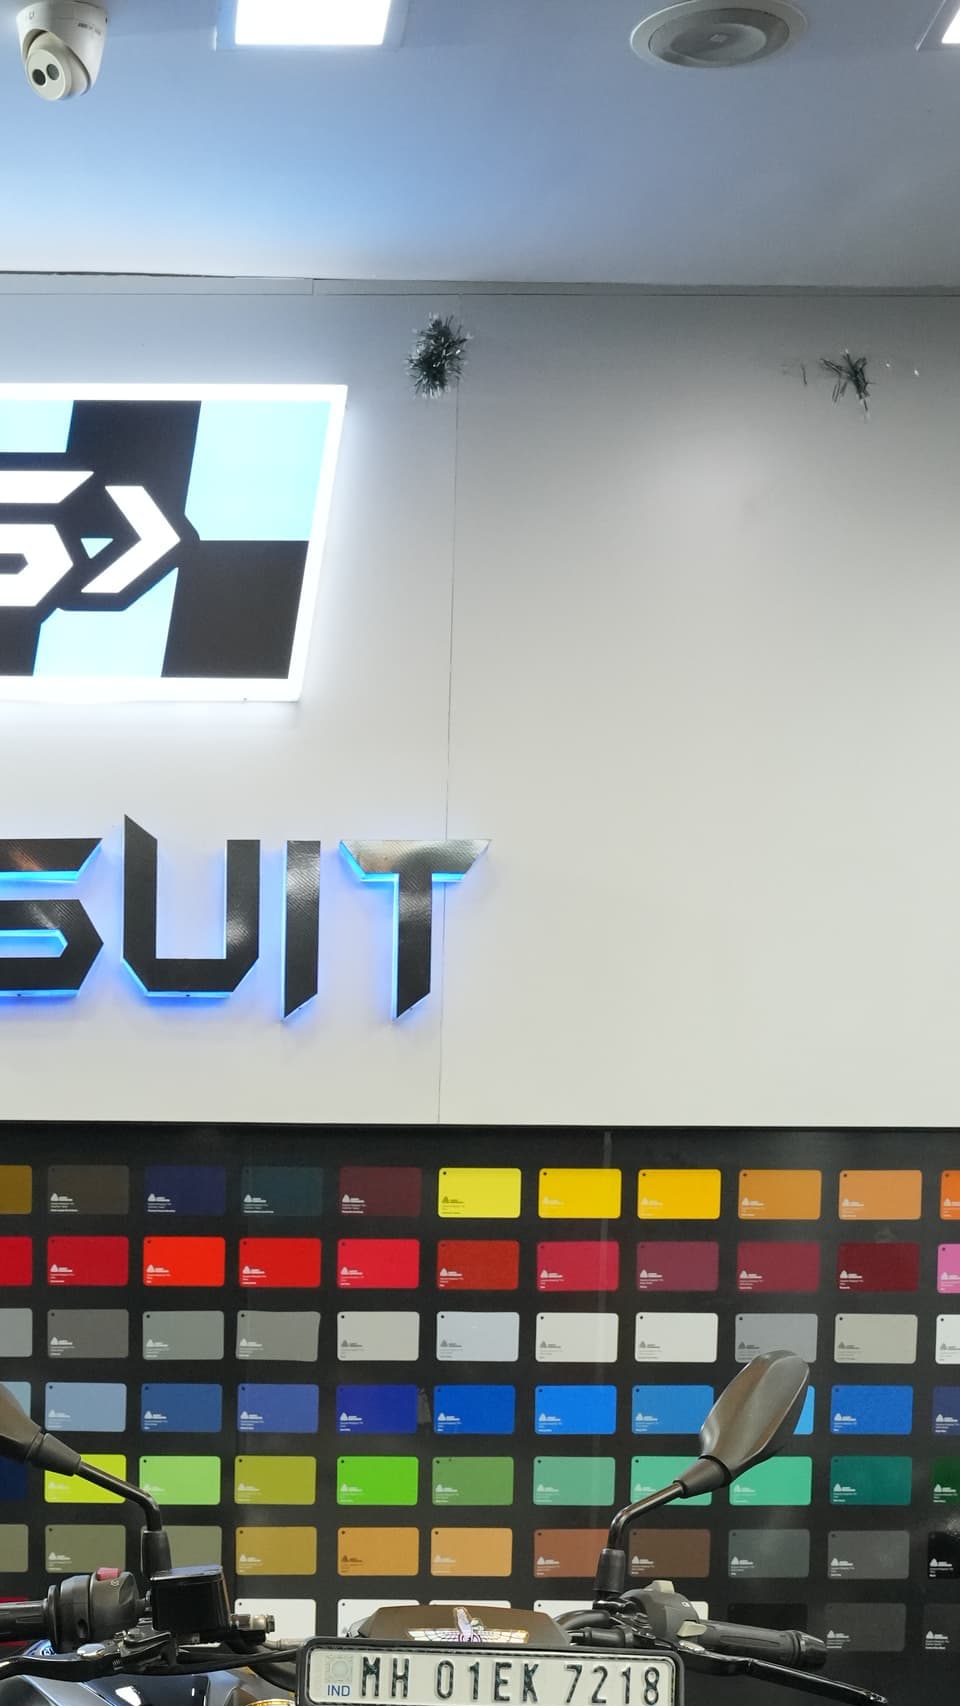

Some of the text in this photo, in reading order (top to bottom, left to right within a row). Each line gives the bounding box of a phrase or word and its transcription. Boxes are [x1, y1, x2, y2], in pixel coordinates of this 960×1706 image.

[326, 1684, 351, 1698] IND
[361, 1655, 411, 1699] MH
[565, 1662, 661, 1706] 7218
